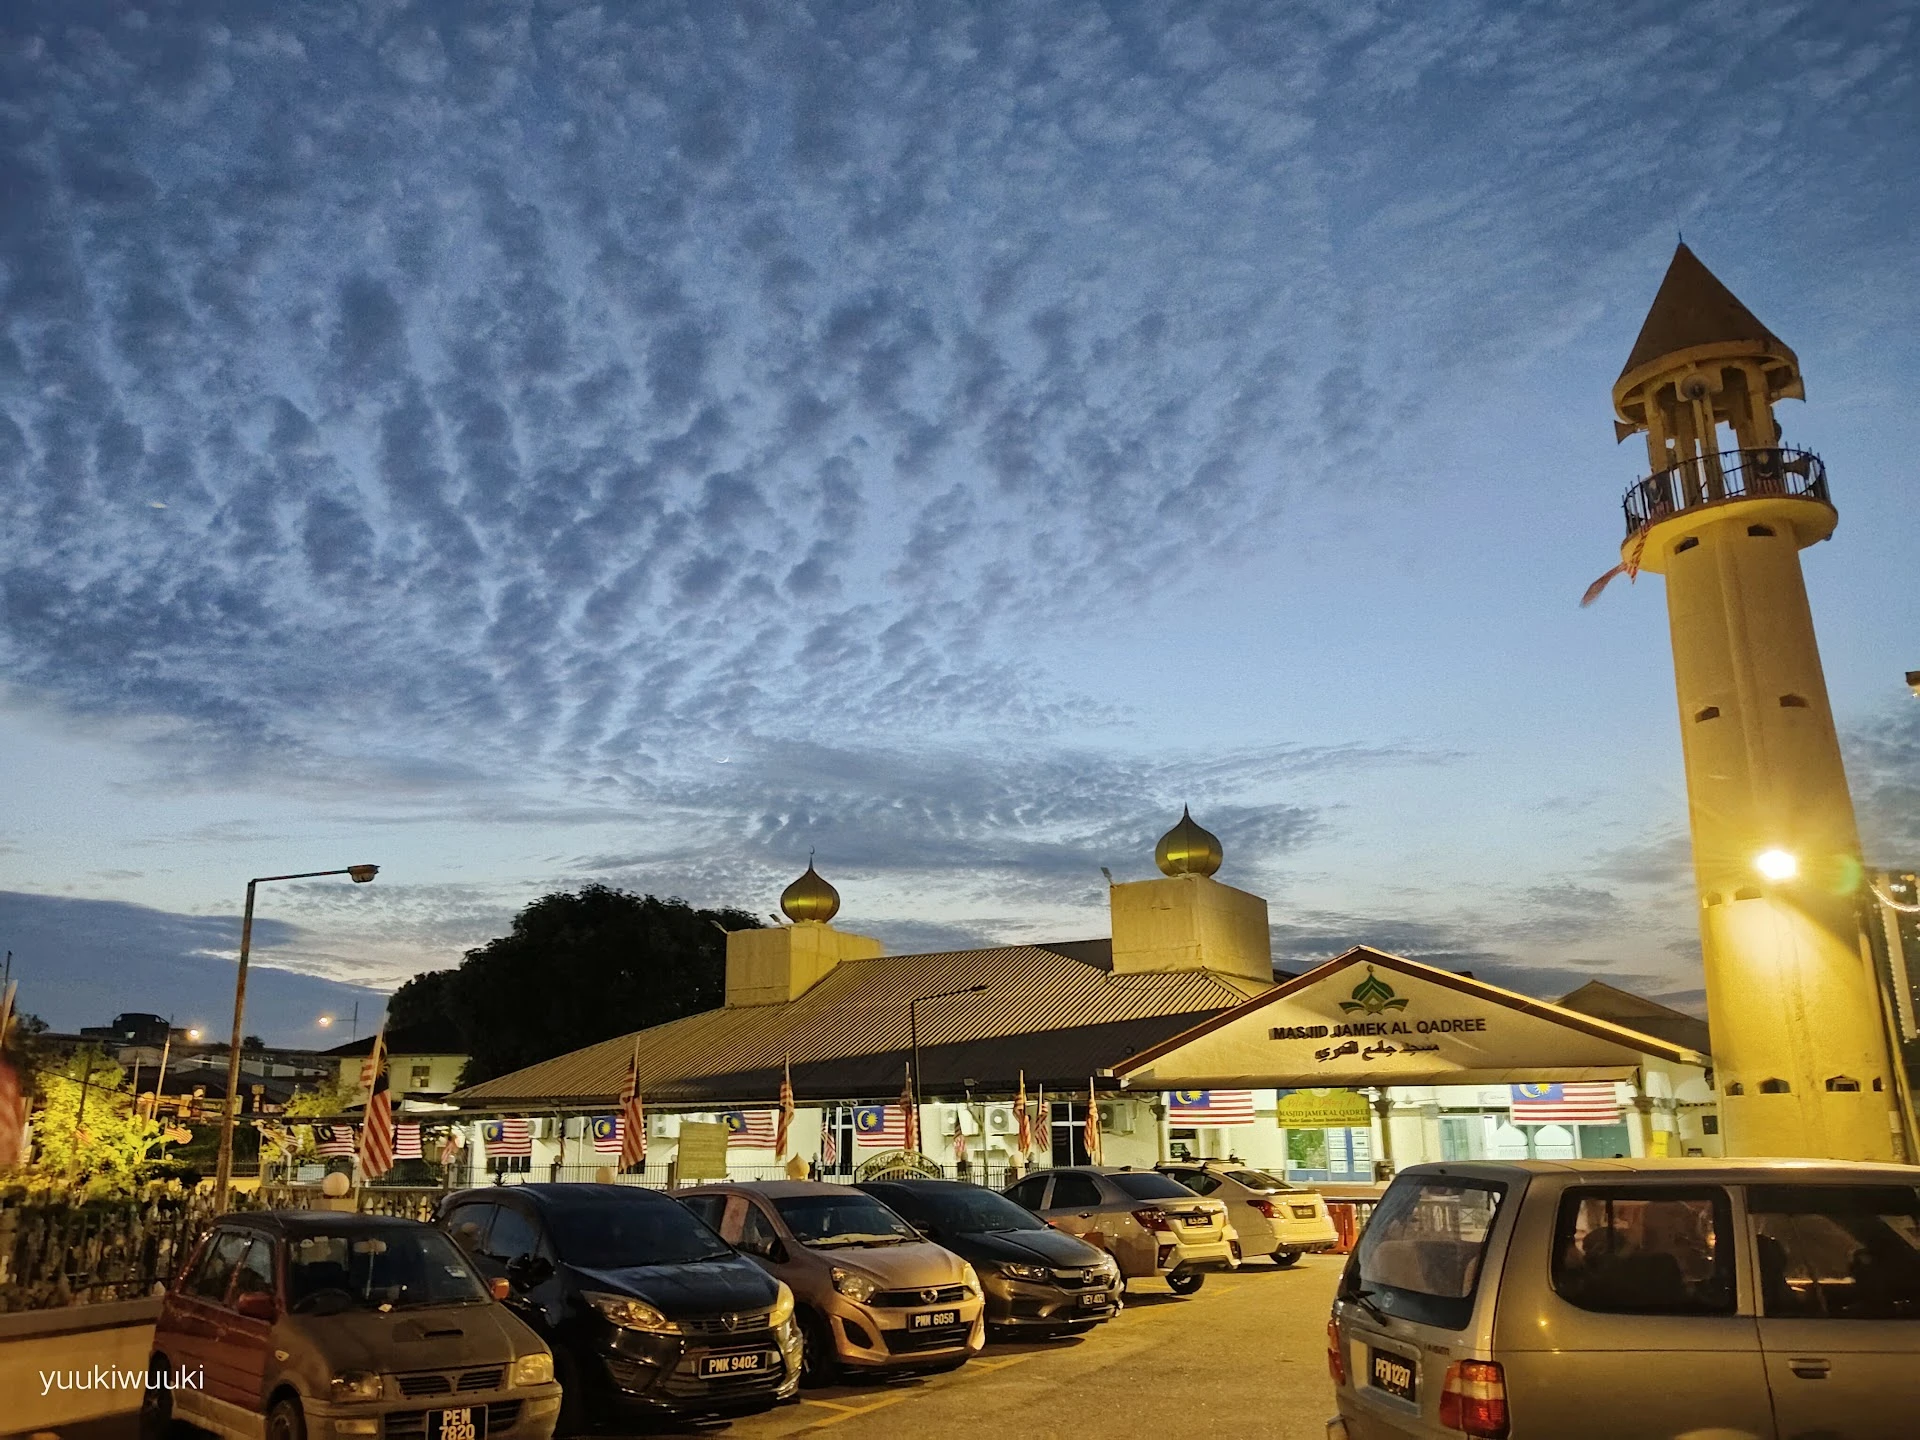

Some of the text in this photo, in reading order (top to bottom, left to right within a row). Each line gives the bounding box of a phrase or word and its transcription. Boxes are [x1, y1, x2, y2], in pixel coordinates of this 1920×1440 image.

[1270, 1018, 1487, 1040] MASJID JAMEK AL QADREE
[1305, 1109, 1328, 1117] JAMEK
[933, 1312, 955, 1325] 6058
[731, 1354, 759, 1370] 9402
[439, 1424, 476, 1440] 7820
